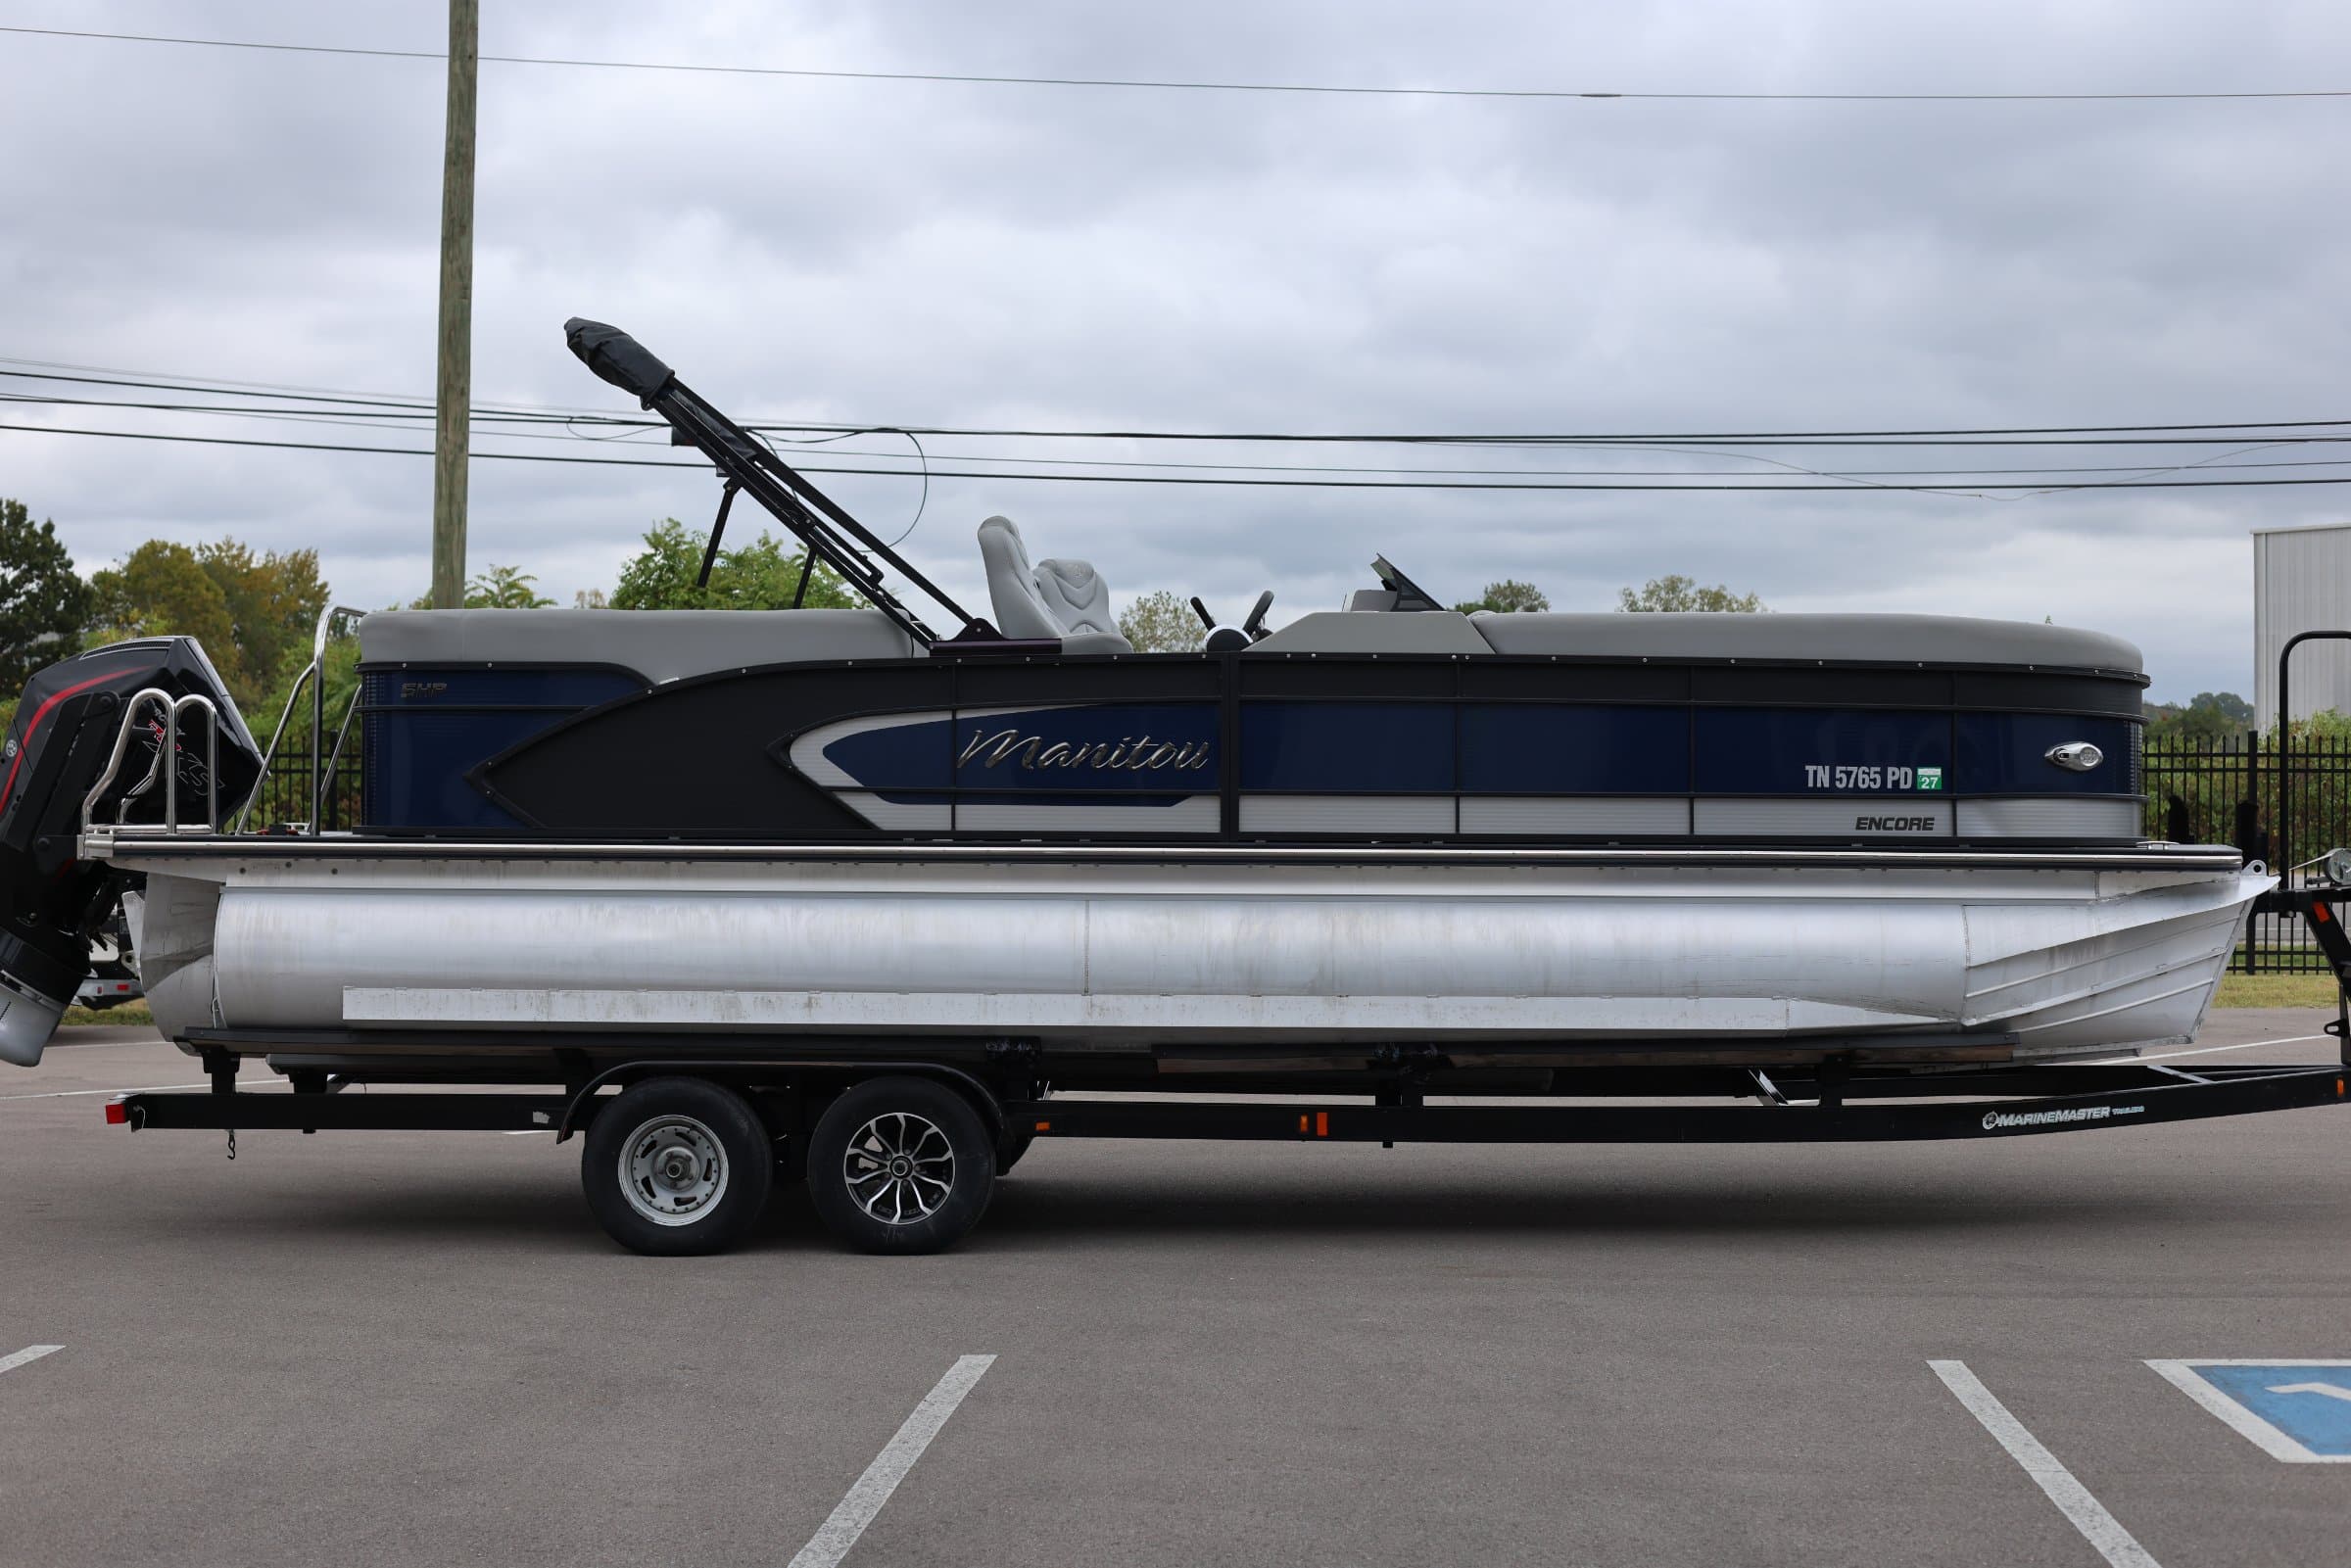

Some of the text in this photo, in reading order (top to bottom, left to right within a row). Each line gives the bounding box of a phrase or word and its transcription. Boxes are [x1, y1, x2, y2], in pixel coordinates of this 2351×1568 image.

[956, 730, 1209, 770] Manitou
[1805, 765, 1912, 789] TN 5765 PD
[1921, 777, 1939, 789] 27
[1855, 816, 1935, 831] ENCORE
[1998, 1107, 2111, 1127] MARINEMASTER
